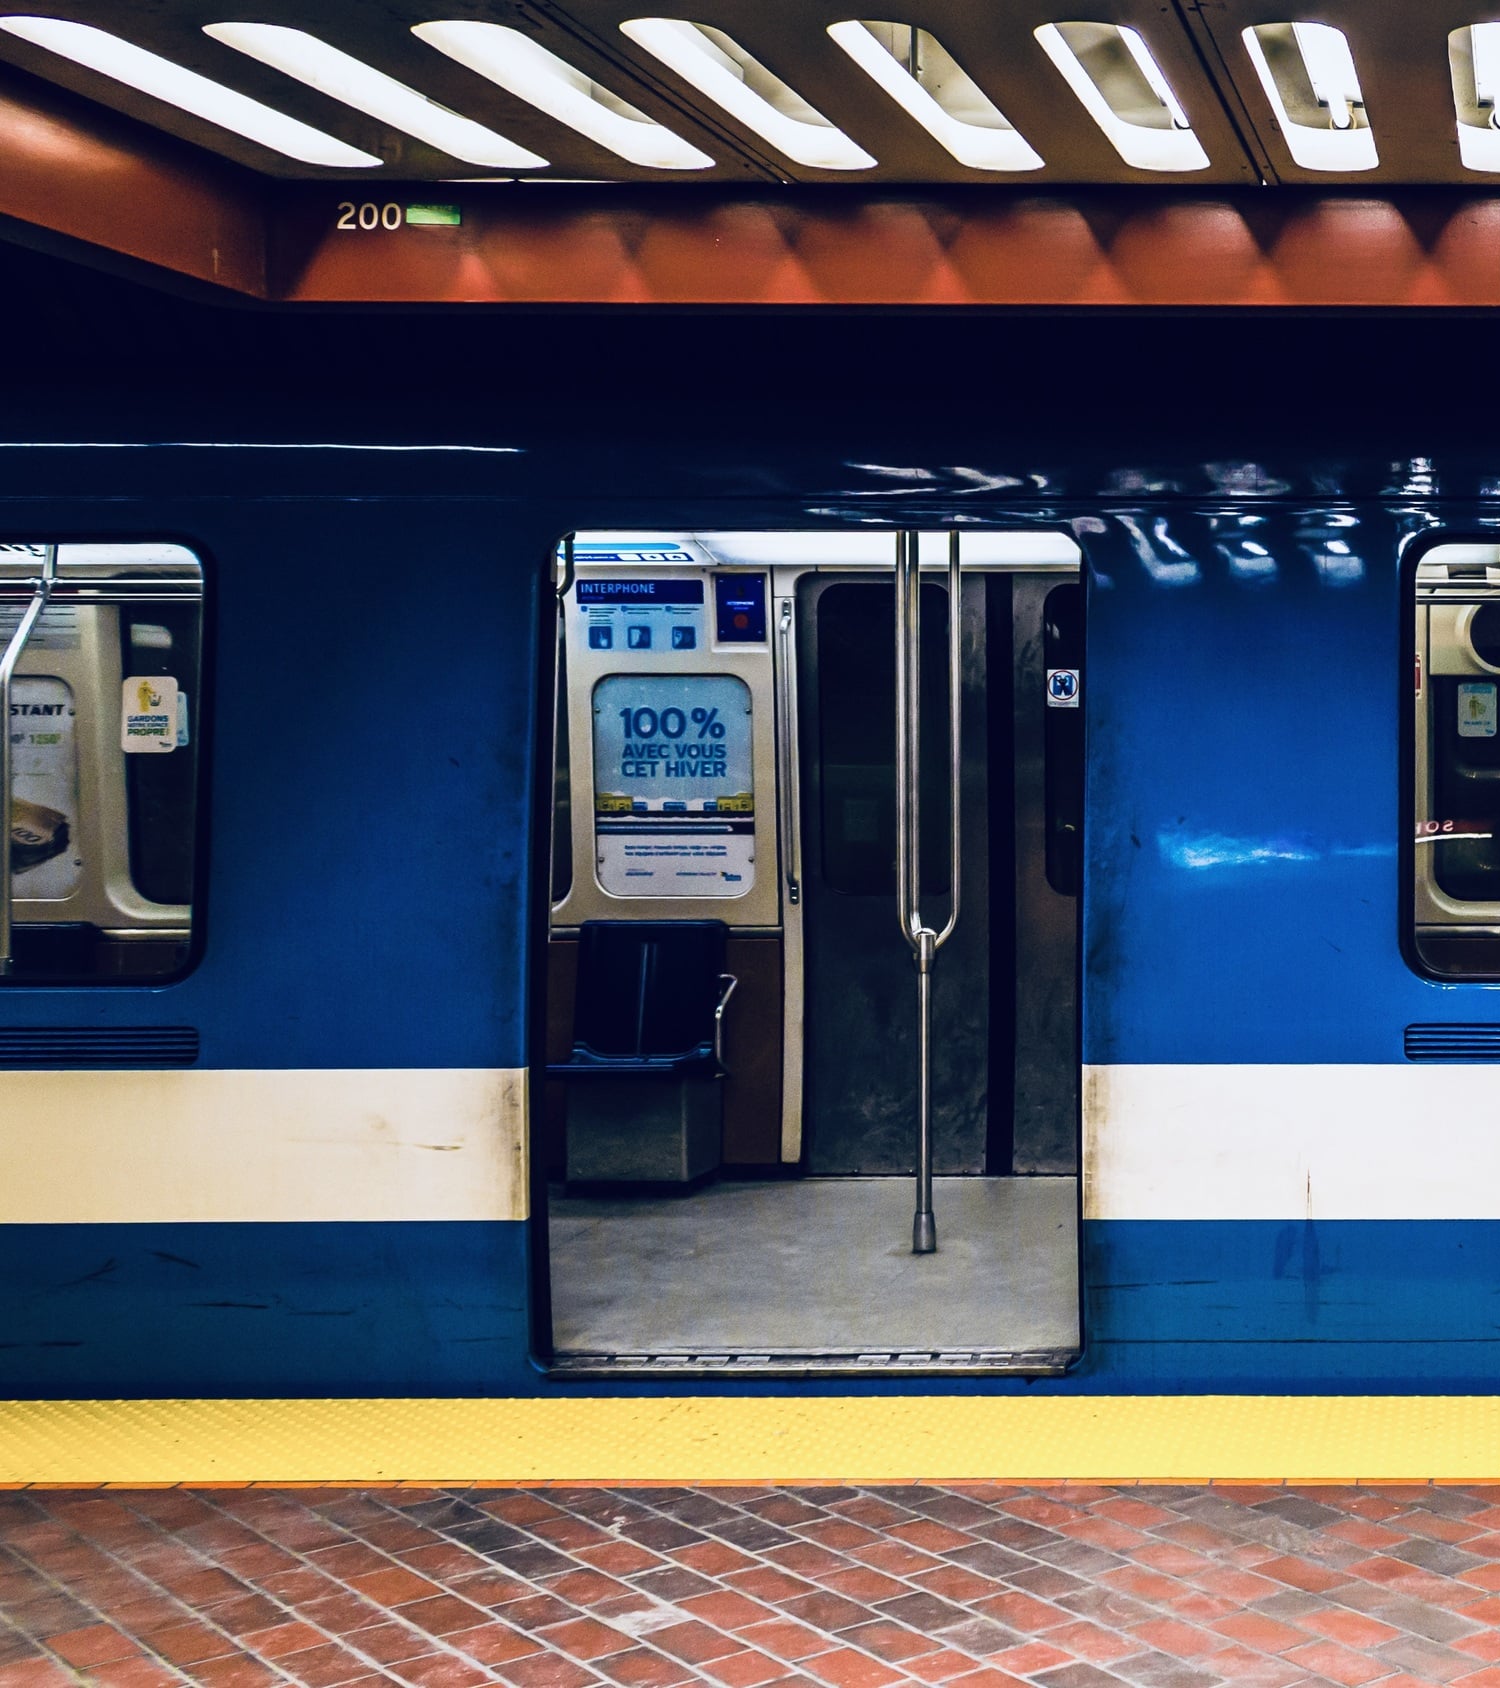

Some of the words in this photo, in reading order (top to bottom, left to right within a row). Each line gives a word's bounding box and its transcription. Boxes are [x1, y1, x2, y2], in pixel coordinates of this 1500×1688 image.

[337, 202, 401, 230] 200
[581, 583, 655, 594] INTERPHONE
[622, 743, 670, 760] AVEC
[674, 743, 727, 760] VOUS
[621, 760, 660, 778] CET
[665, 760, 727, 778] HIVER
